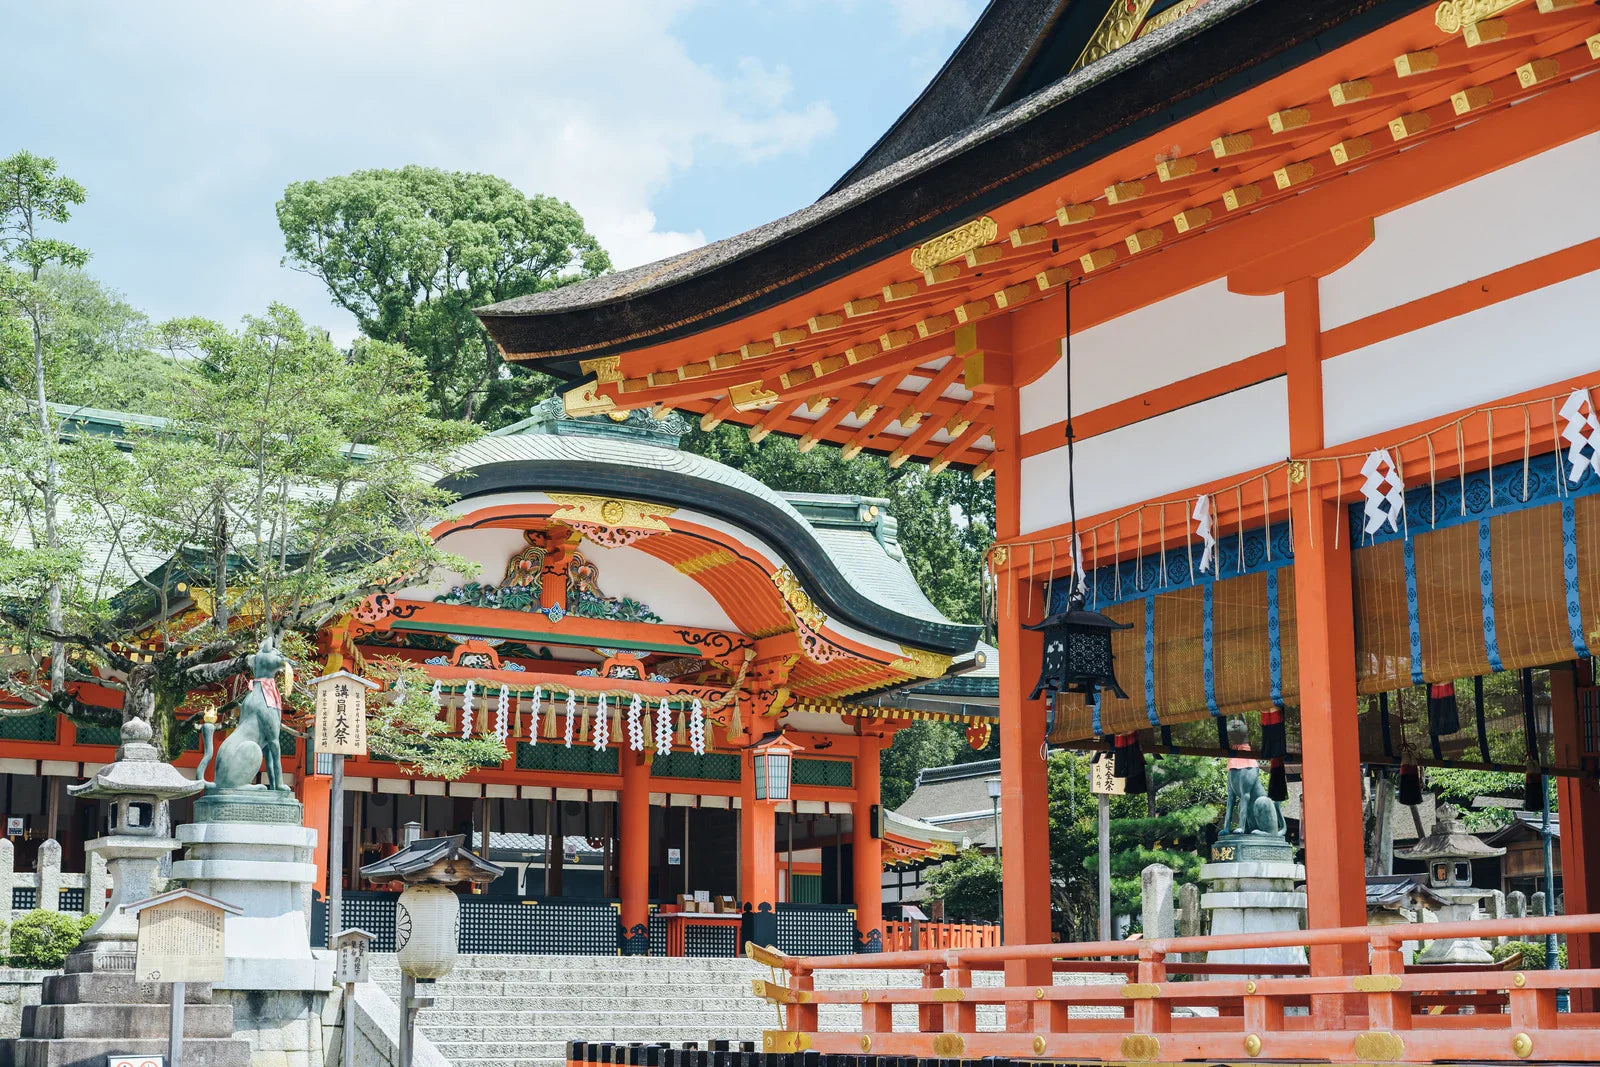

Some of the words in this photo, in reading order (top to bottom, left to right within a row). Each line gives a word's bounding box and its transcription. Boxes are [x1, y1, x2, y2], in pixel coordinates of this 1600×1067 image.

[334, 684, 350, 746] 講員大祭
[1104, 758, 1115, 791] 安全祭
